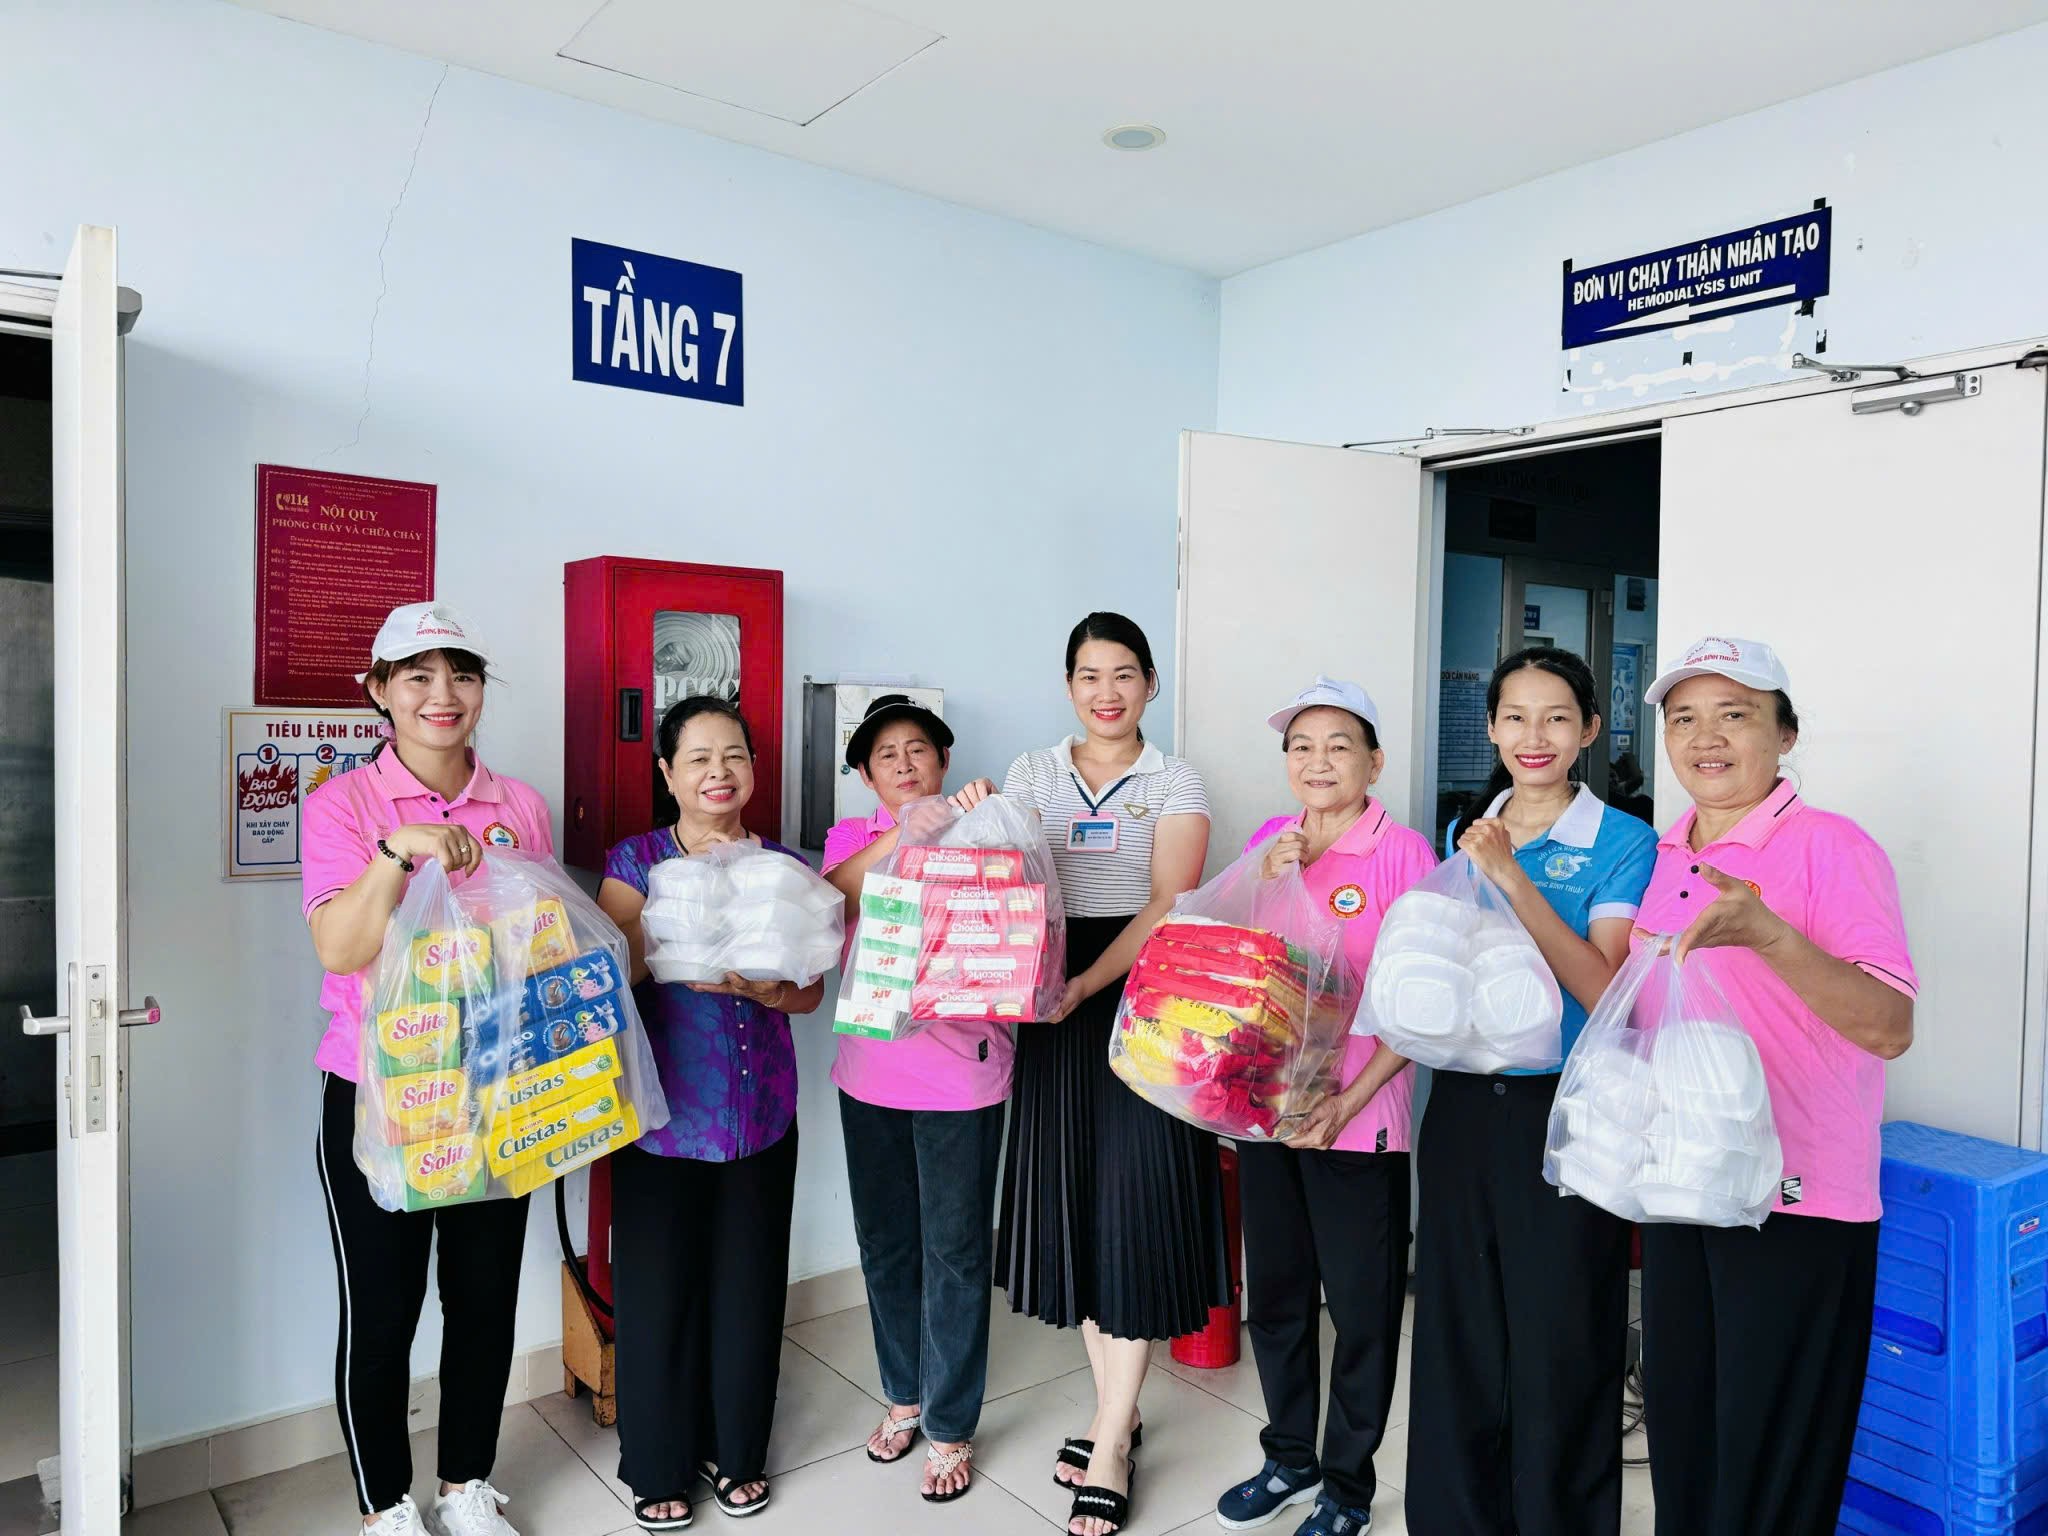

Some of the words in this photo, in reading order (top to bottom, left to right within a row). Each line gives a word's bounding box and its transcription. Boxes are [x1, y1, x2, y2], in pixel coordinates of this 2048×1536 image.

[1573, 274, 1604, 305] ĐƠN
[1609, 270, 1624, 300] VỊ
[1628, 259, 1672, 292] CHẠY
[1676, 243, 1722, 281] THẬN
[1727, 230, 1776, 269] NHÂN
[1781, 222, 1820, 259] TẠO
[1627, 279, 1725, 312] HEMODIALYSIS
[1729, 269, 1763, 289] UNIT
[583, 260, 699, 383] TẦNG
[712, 311, 736, 387] 7
[290, 493, 309, 506] 114
[320, 504, 344, 519] NỘI
[348, 509, 378, 522] QUY
[272, 517, 309, 529] PHÒNG
[312, 520, 342, 532] CHÁY
[344, 524, 360, 535] VÀ
[362, 526, 391, 539] CHỮA
[393, 530, 423, 541] CHÁY
[266, 720, 301, 738] TIÊU
[308, 720, 347, 740] LỆNH
[262, 747, 273, 760] 1
[320, 747, 332, 760] 2
[249, 776, 277, 791] BÁO
[242, 791, 288, 811] ĐỘNG
[391, 1013, 449, 1041] Solite
[400, 1080, 457, 1111] Solite
[498, 1118, 568, 1160] Custas
[544, 1119, 624, 1168] Custas
